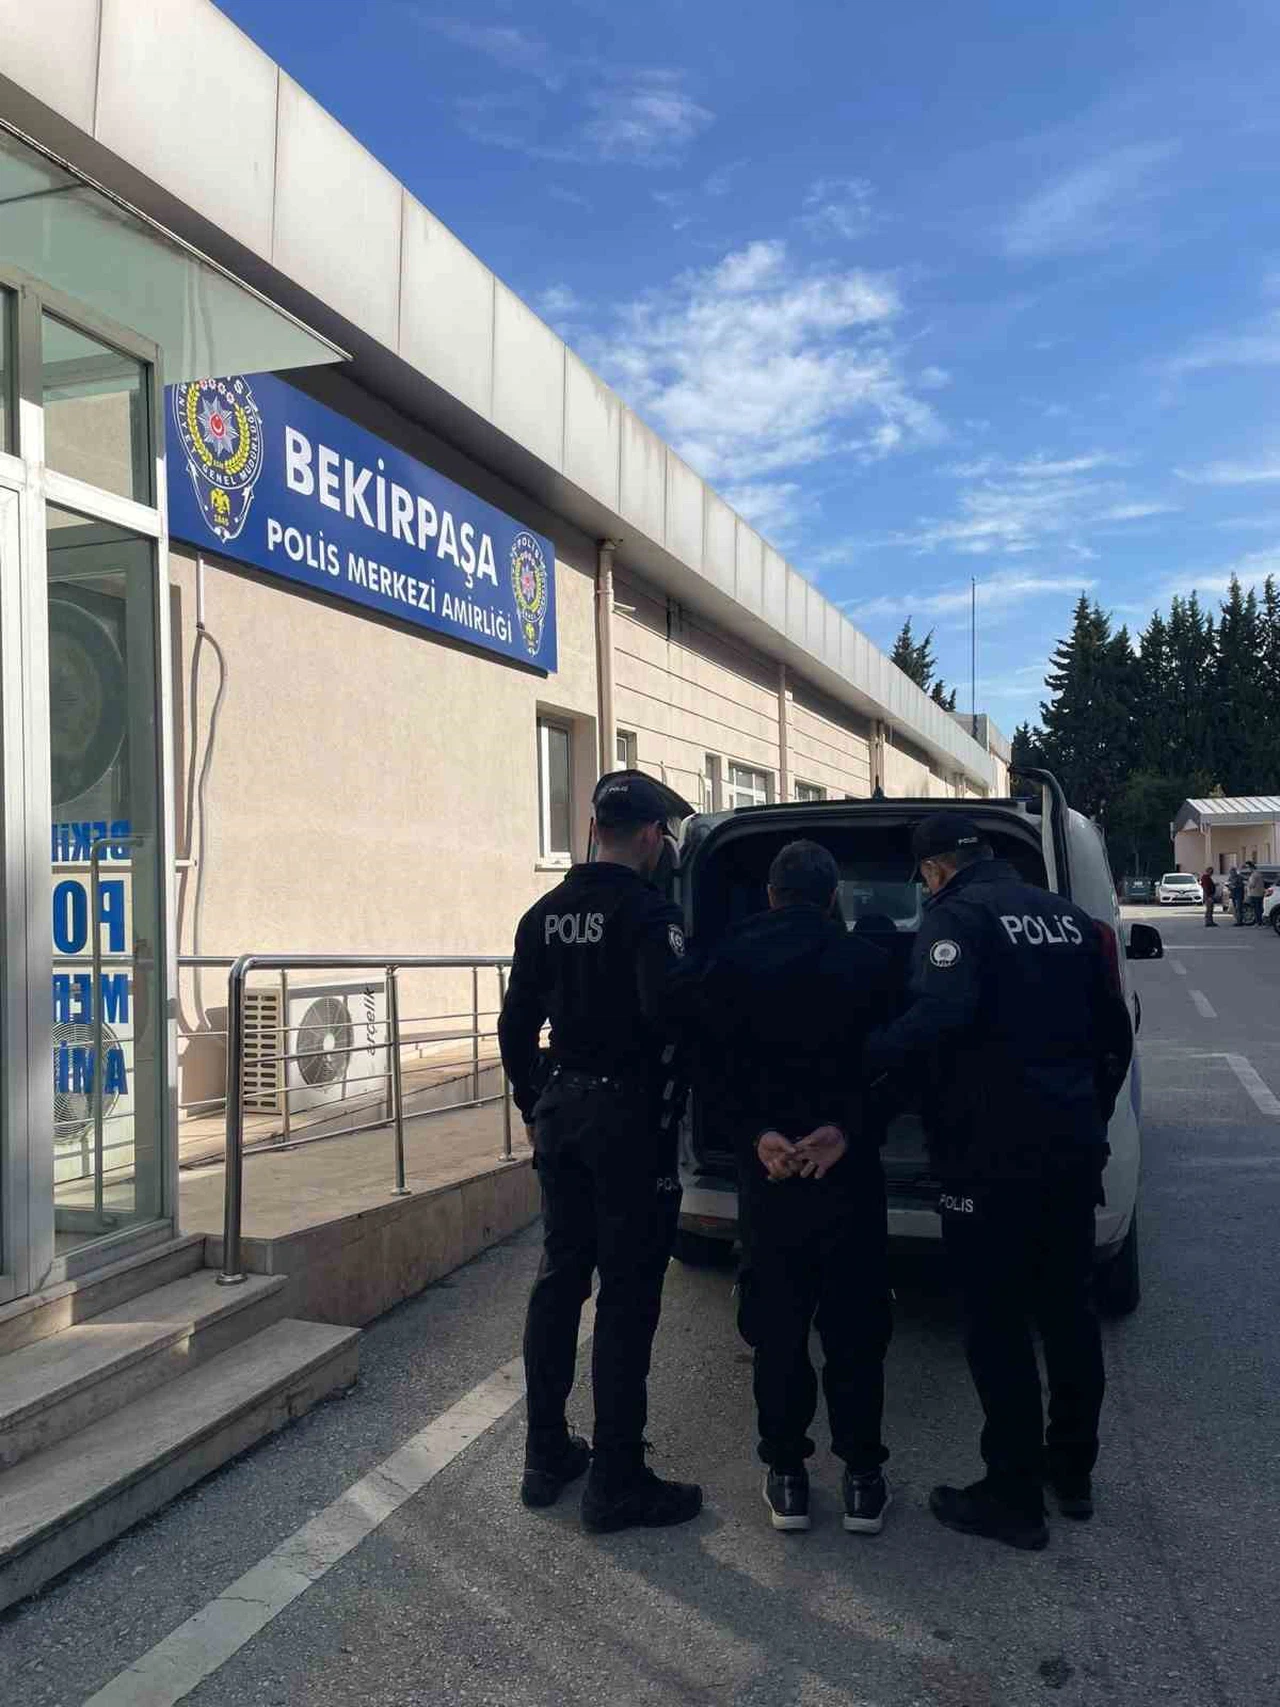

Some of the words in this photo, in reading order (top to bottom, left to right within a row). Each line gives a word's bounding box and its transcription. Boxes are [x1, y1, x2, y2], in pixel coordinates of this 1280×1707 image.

[286, 425, 498, 589] BEKİRPAŞA
[267, 518, 340, 577] POLİS
[349, 552, 436, 614] MERKEZİ
[442, 592, 512, 643] AMİRLİĞİ
[1000, 914, 1082, 945] POLİS
